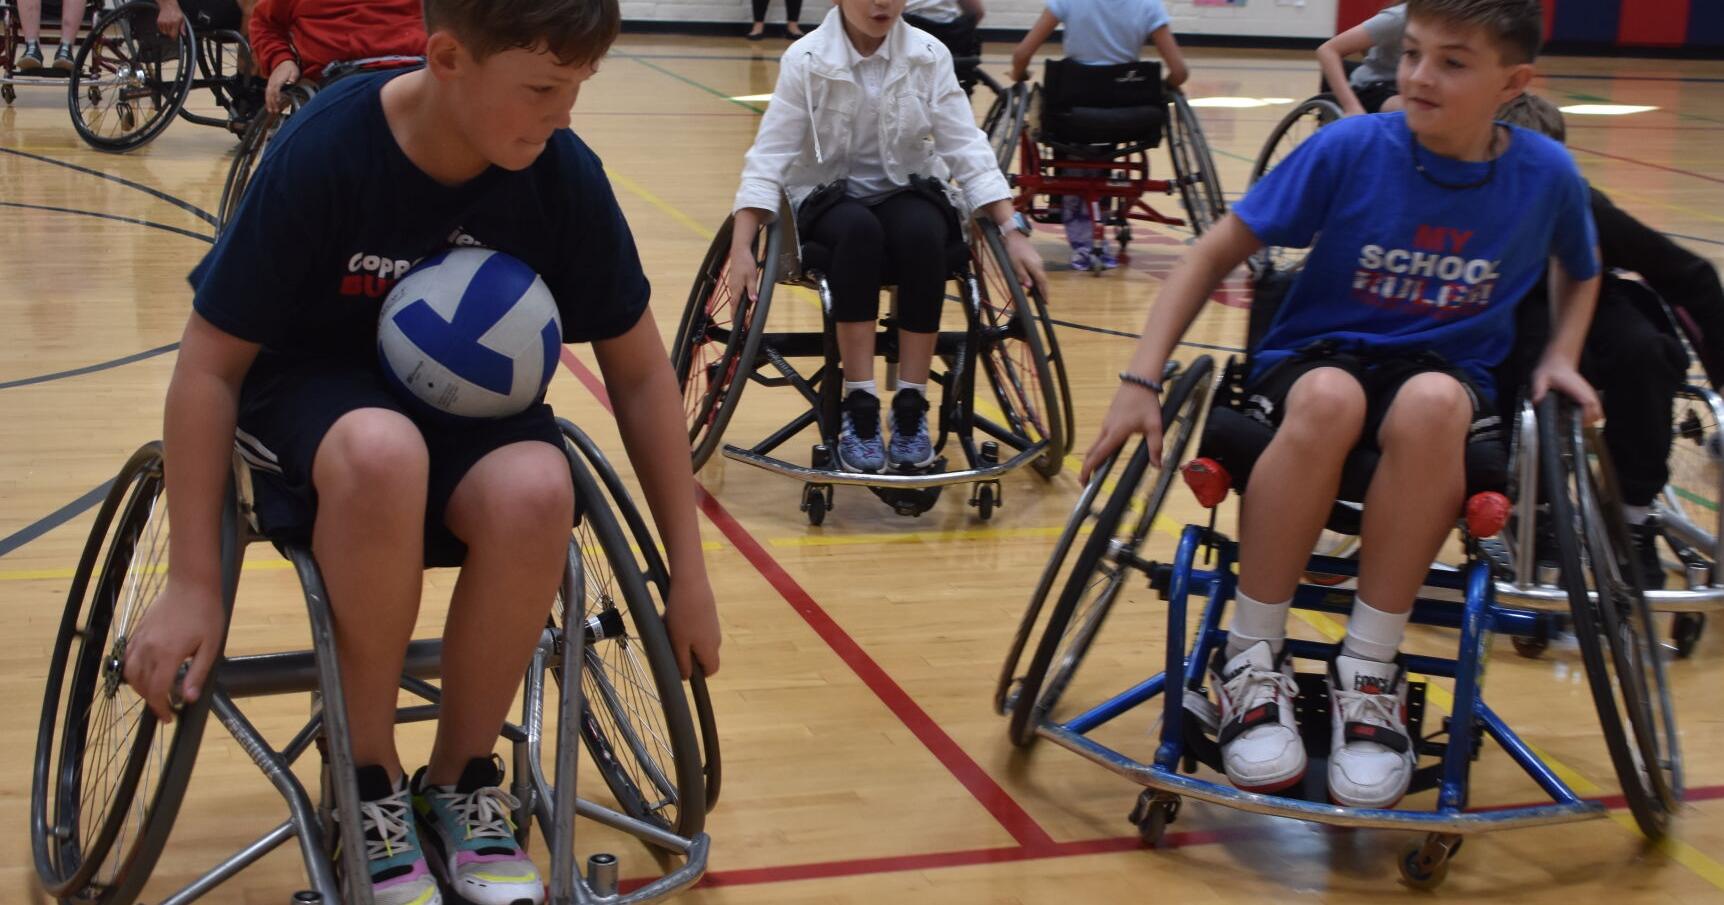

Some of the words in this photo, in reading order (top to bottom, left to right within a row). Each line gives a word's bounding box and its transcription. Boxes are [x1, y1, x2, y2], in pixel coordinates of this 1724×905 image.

[1412, 224, 1474, 252] MY
[1358, 244, 1501, 284] SCHOOL
[340, 274, 398, 298] BU
